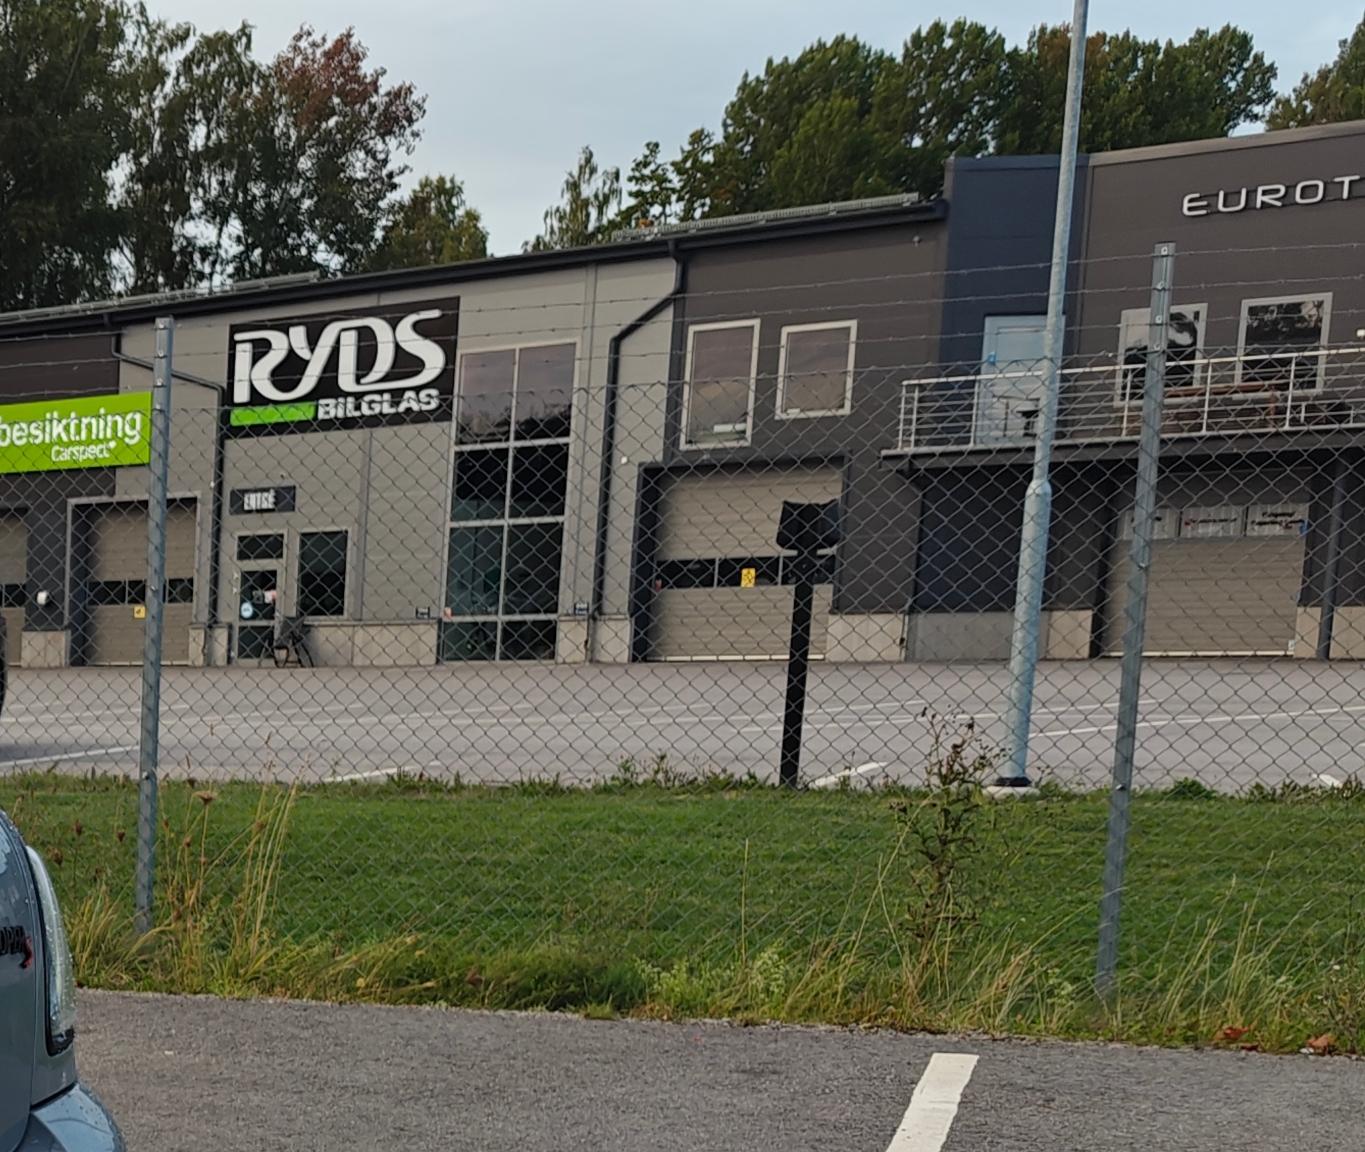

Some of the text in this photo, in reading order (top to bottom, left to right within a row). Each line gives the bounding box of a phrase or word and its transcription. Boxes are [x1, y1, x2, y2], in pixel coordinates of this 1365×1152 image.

[1182, 175, 1361, 216] EUROT
[233, 309, 446, 403] RYDS
[318, 388, 440, 420] BILGLAS
[51, 441, 110, 462] Carspect
